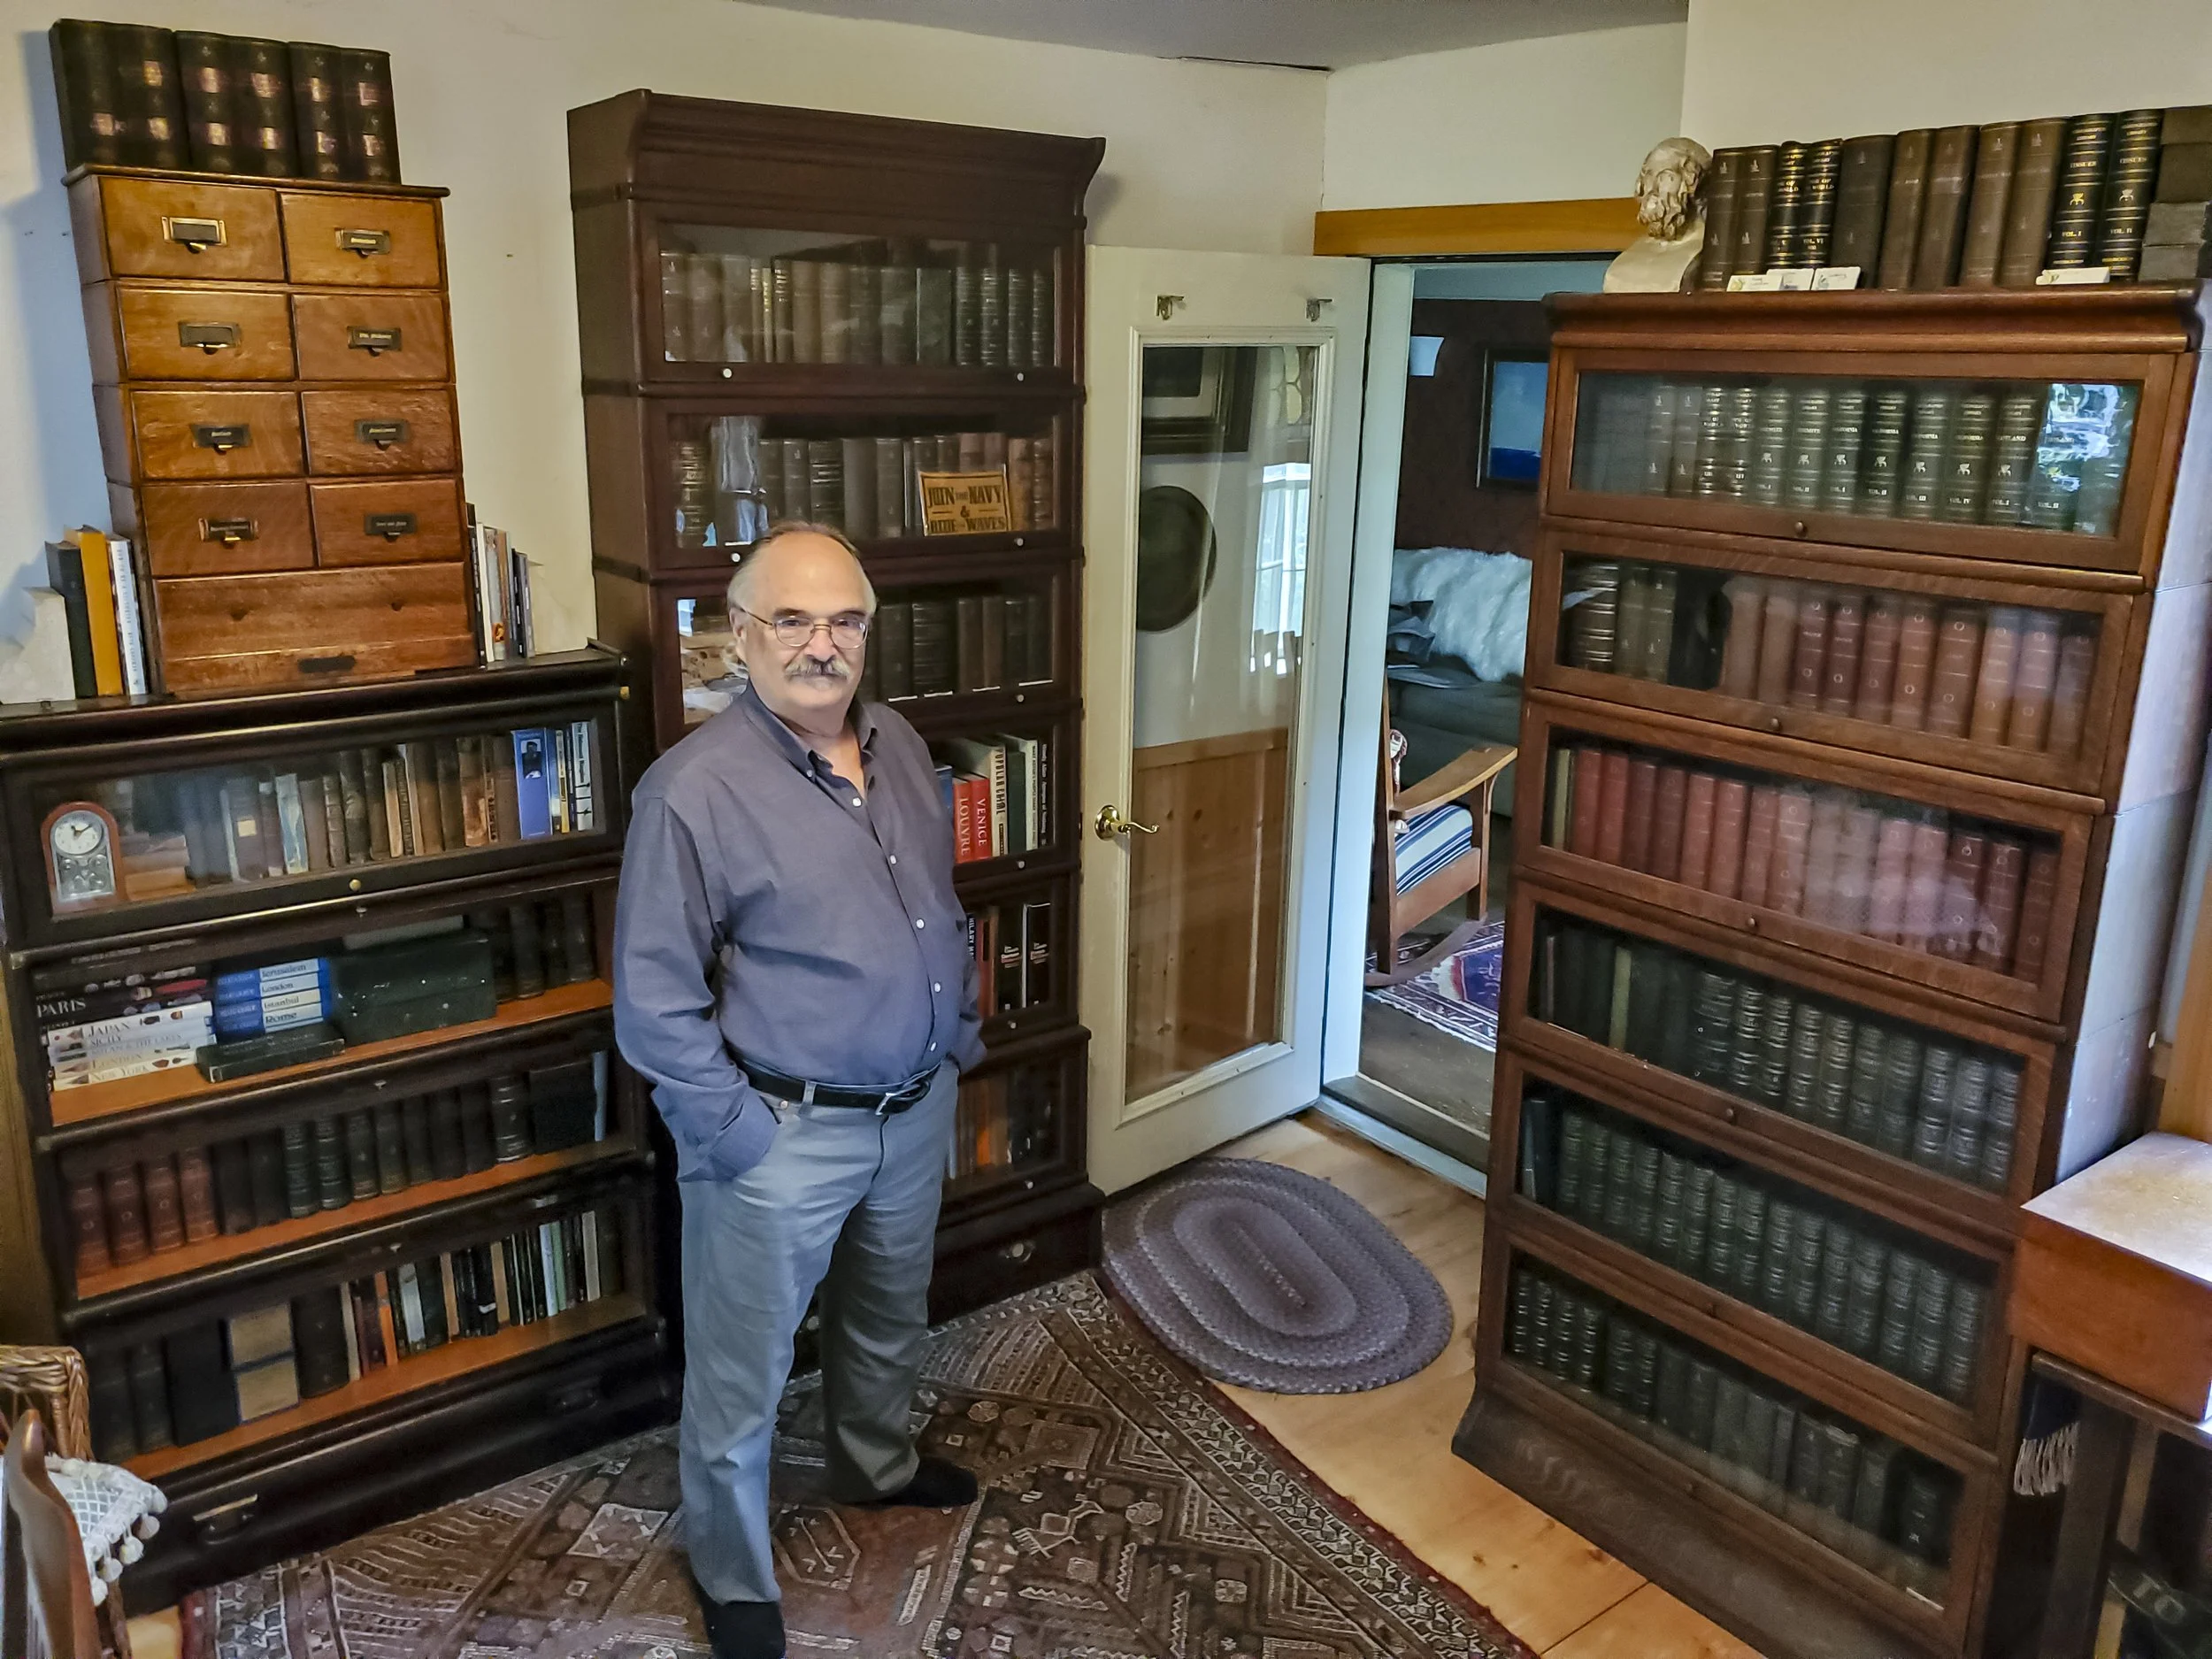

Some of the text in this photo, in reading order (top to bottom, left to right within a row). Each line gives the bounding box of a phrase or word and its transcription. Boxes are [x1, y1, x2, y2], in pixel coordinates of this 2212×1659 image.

[926, 487, 955, 508] JOIN
[968, 485, 1002, 504] NAVY
[960, 505, 971, 518] &
[965, 517, 1006, 531] WAVES
[959, 797, 971, 856] LOUVRE
[976, 798, 987, 847] VENICE
[262, 981, 294, 993] London
[36, 999, 87, 1018] PARIS
[265, 996, 300, 1009] Istanbul
[265, 1012, 297, 1024] Rome
[88, 1021, 130, 1038] JAPAN
[90, 1034, 122, 1048] SICILY
[119, 1064, 150, 1078] YORK
